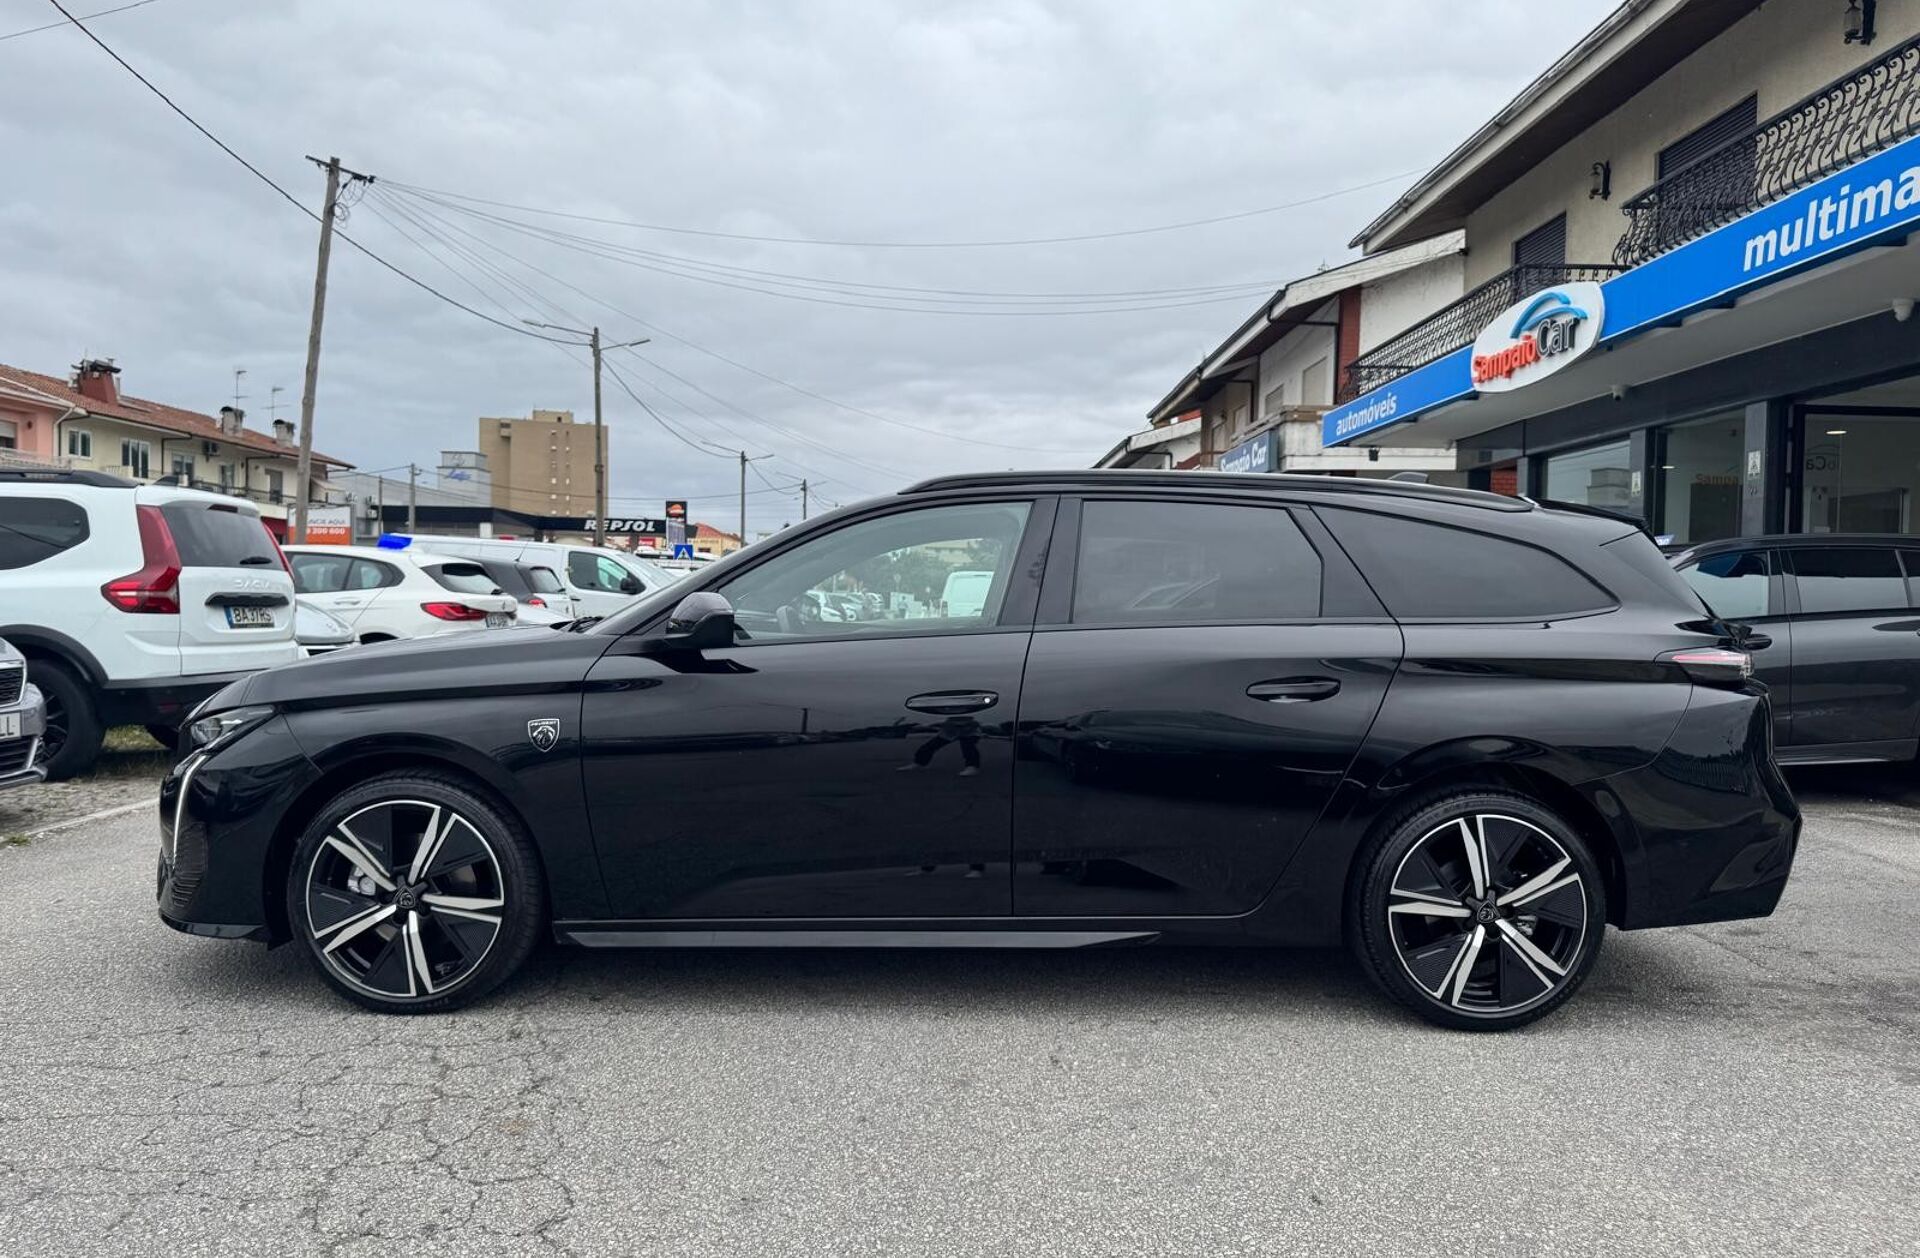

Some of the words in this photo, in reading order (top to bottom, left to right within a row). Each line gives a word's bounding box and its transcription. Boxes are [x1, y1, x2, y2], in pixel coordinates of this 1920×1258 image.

[1743, 166, 1920, 272] multima
[1336, 392, 1397, 436] automóveis
[1252, 441, 1267, 467] Car
